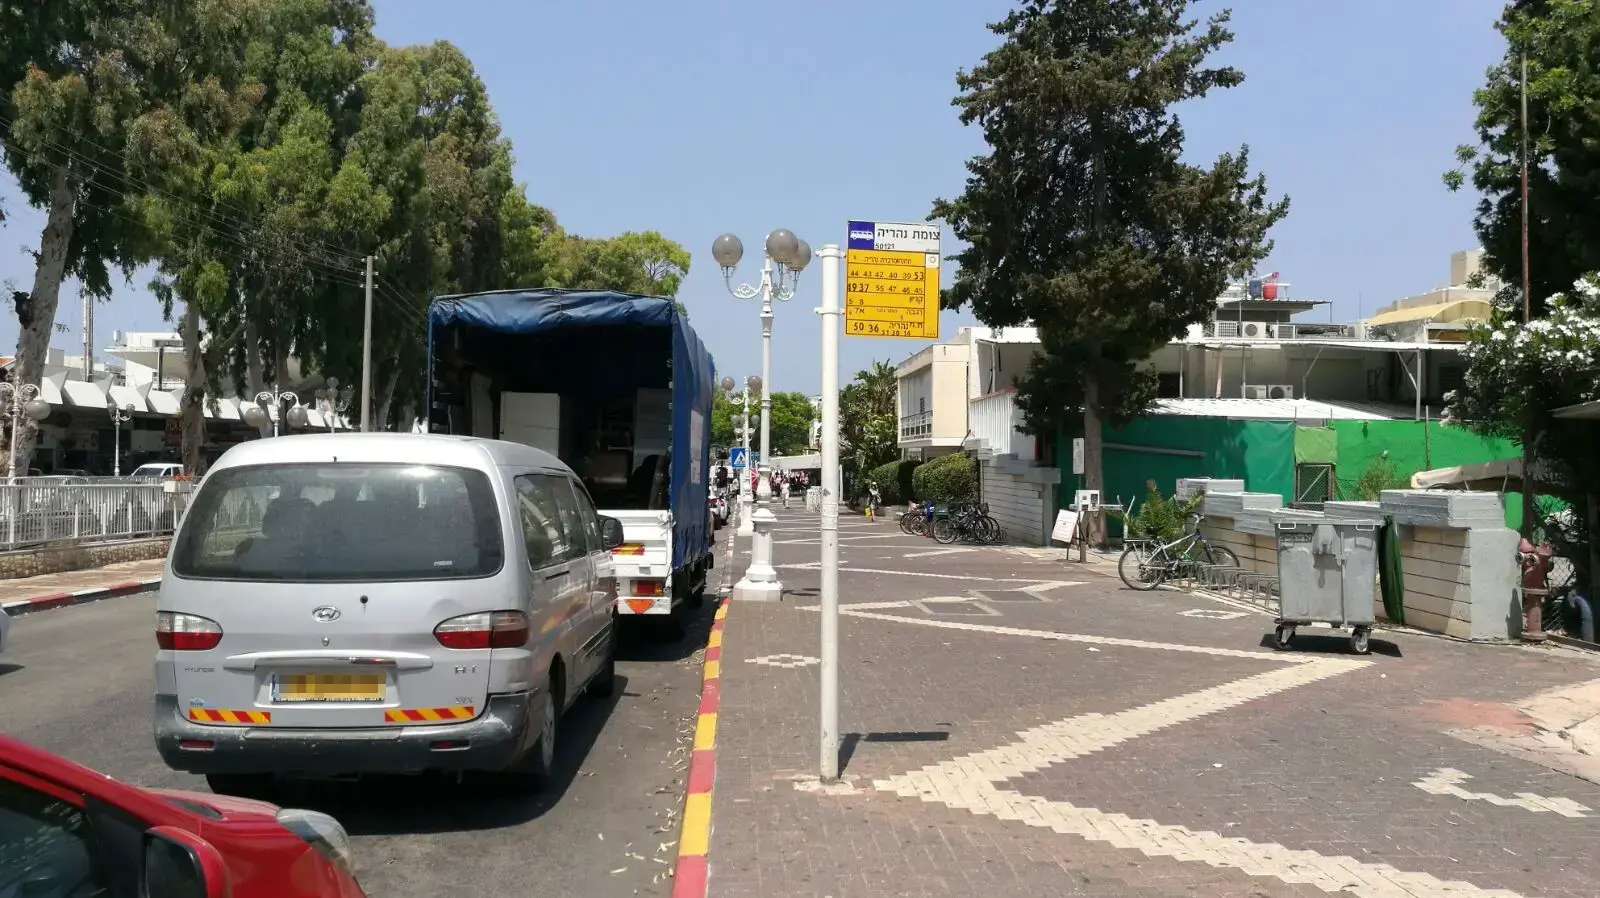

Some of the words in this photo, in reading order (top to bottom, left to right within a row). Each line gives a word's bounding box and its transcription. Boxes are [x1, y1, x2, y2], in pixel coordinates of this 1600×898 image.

[877, 228, 908, 239] נהריה
[912, 230, 940, 240] צומת
[875, 242, 895, 250] 50121
[914, 271, 924, 280] 53
[859, 283, 870, 292] 37
[853, 322, 865, 331] 50
[868, 324, 879, 333] 36
[889, 322, 909, 330] נהריה
